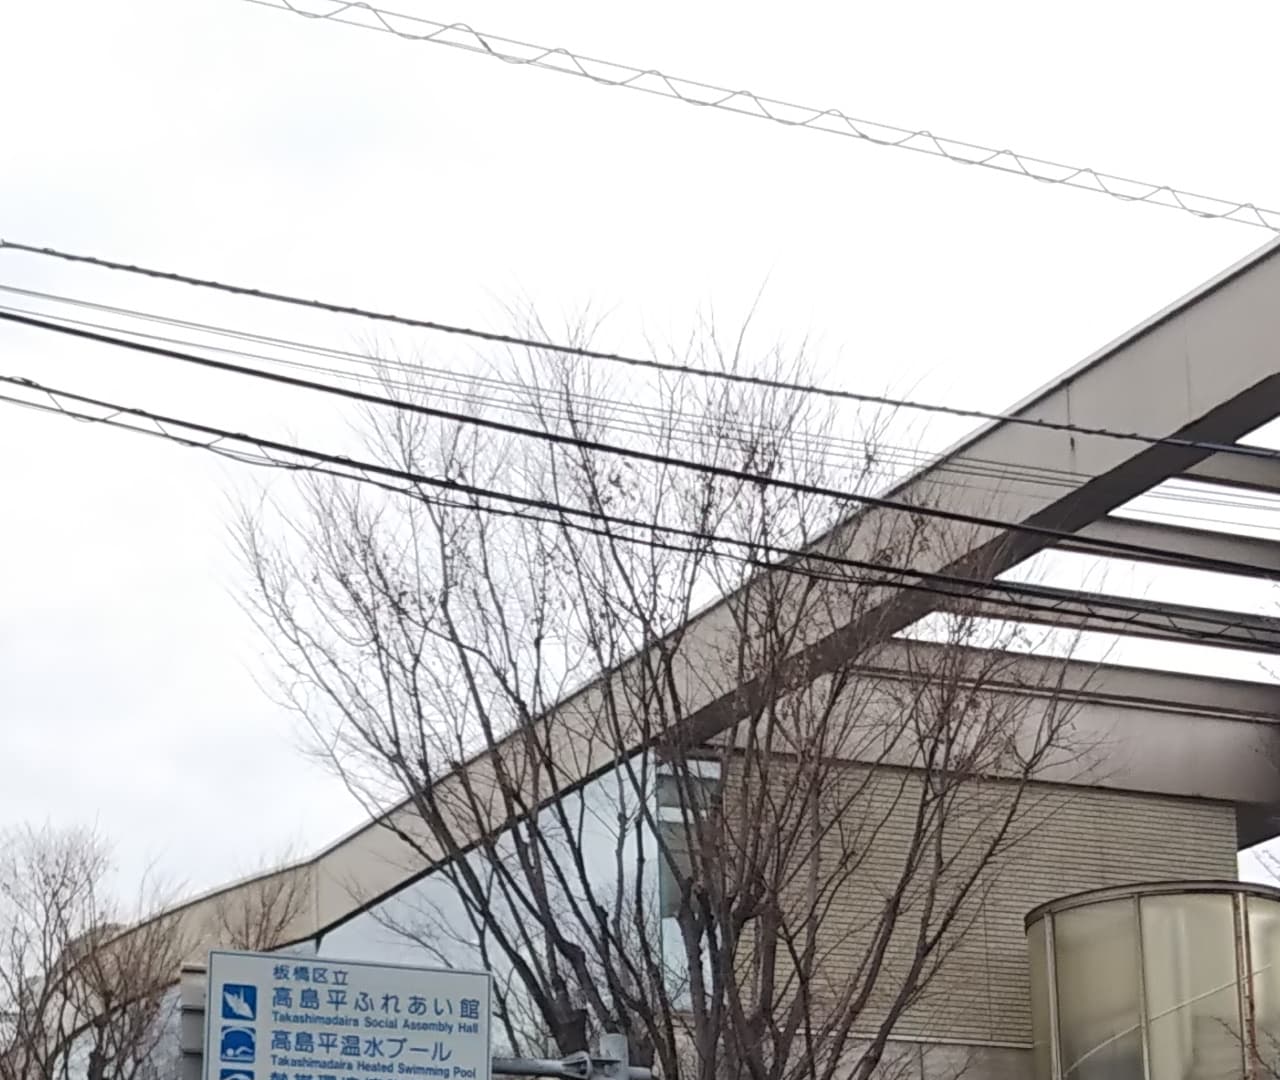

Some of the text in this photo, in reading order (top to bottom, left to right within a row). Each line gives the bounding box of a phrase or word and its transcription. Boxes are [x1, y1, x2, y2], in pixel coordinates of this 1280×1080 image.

[273, 964, 349, 987] 板橋区立
[272, 987, 480, 1020] 高島平ふれあい館
[272, 1011, 479, 1035] Takashimadaira Social Assembly Hall
[271, 1030, 452, 1062] 高島平温水プール
[271, 1054, 476, 1079] Takashimadaira Heated Swimming Pool
